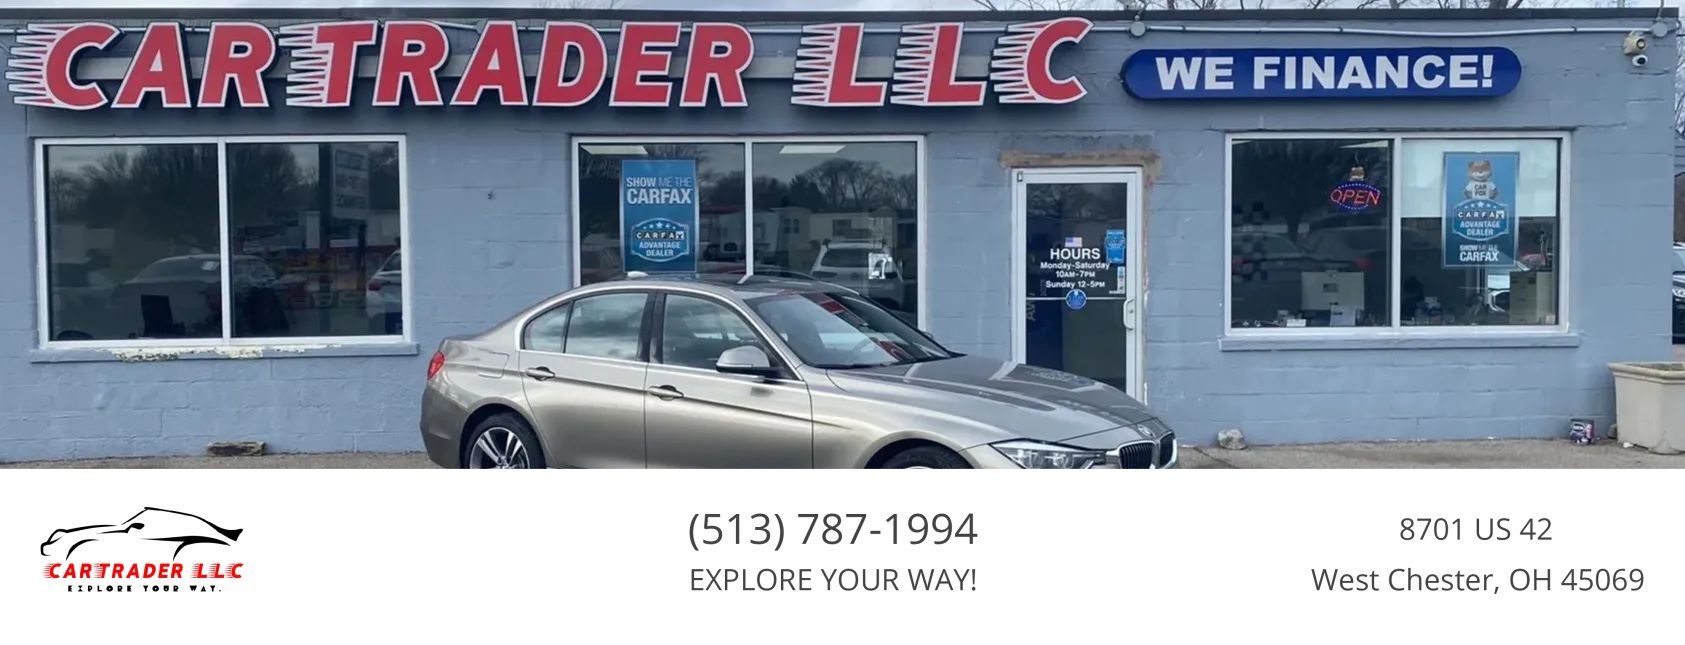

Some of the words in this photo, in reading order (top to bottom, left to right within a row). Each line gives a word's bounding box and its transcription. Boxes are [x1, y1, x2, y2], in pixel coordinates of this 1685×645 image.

[791, 17, 1094, 106] LLC
[1156, 57, 1234, 90] WE
[1253, 55, 1494, 90] FINANCE!
[626, 177, 656, 187] SHOW
[658, 177, 673, 187] ME
[675, 177, 692, 187] THE
[626, 188, 692, 204] CARFAX
[1330, 189, 1380, 205] OPEN
[1460, 220, 1500, 228] ADVANTAGE
[1466, 228, 1494, 236] DEALER
[639, 241, 681, 249] ADVANTAGE
[646, 249, 674, 257] DEALER
[1050, 248, 1101, 260] HOURS
[1459, 251, 1500, 262] CARFAX
[1040, 261, 1110, 270] Monday-Saturday
[1046, 280, 1075, 289] Sunday
